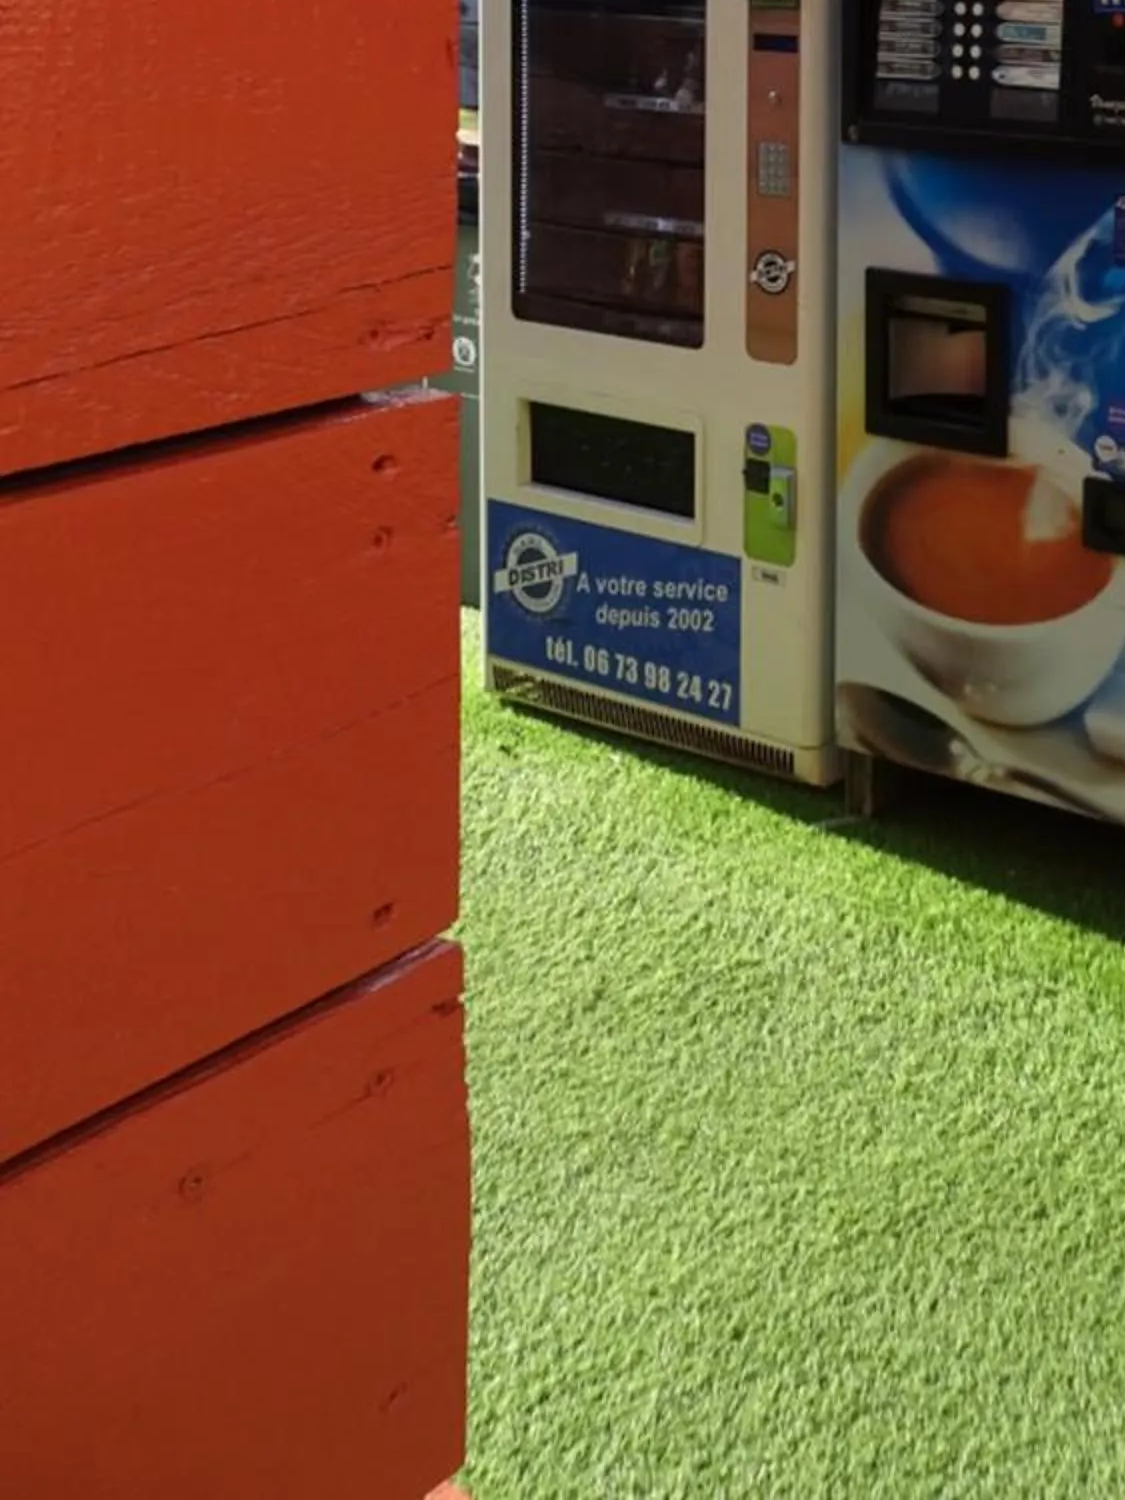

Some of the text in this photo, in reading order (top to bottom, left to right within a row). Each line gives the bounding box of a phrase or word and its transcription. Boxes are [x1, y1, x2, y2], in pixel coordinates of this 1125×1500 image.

[508, 559, 564, 587] DISTRI
[576, 572, 590, 593] A
[595, 574, 647, 598] votre
[652, 578, 729, 603] service
[595, 603, 715, 633] depuis 2002
[545, 636, 733, 712] tél. 06 73 98 24 27
